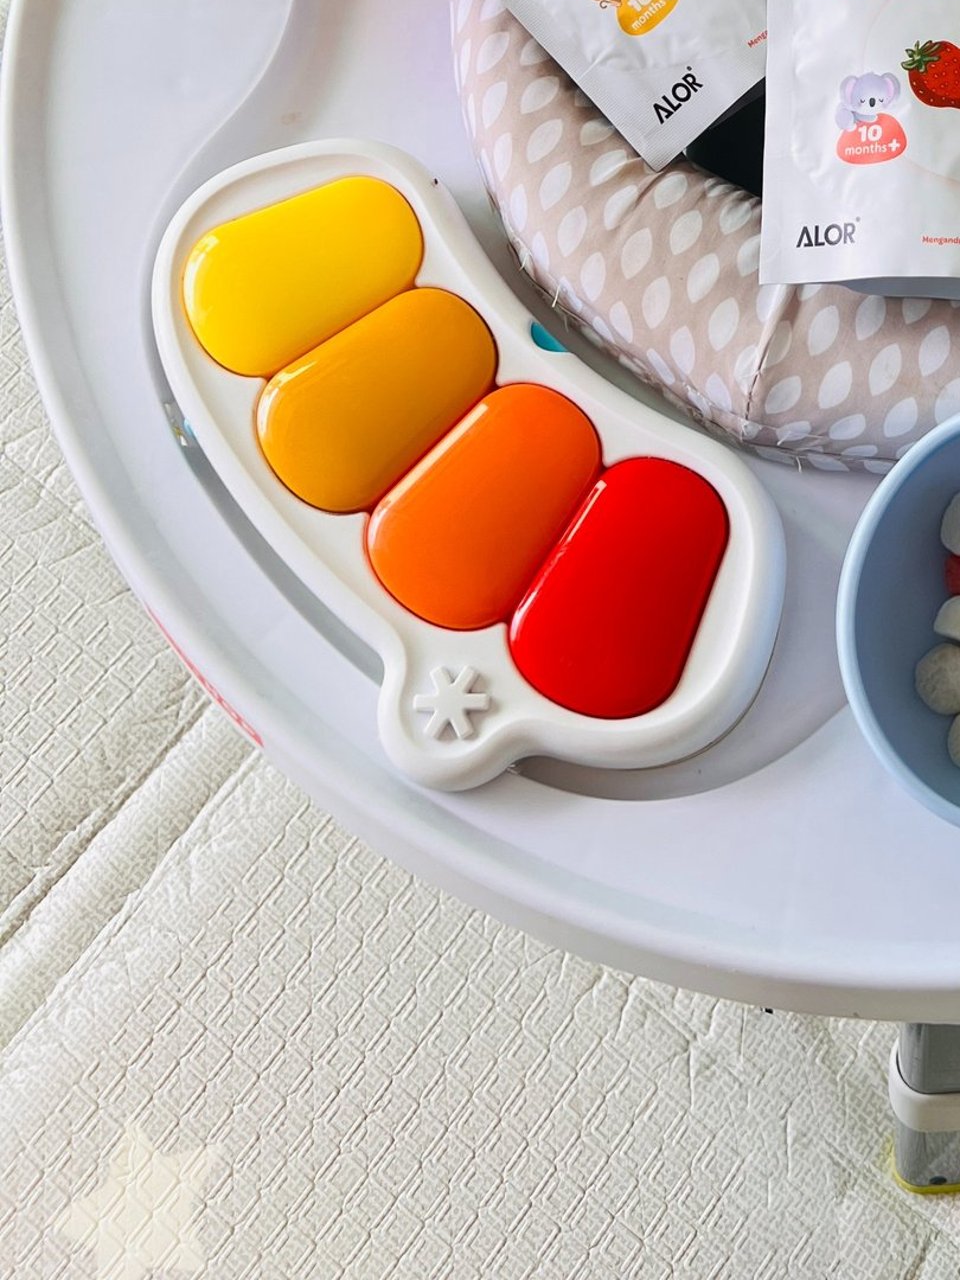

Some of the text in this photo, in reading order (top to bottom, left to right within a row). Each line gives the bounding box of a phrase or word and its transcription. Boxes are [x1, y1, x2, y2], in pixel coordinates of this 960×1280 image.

[652, 72, 704, 124] ALOR
[858, 124, 883, 142] 10
[796, 222, 856, 248] ALOR
